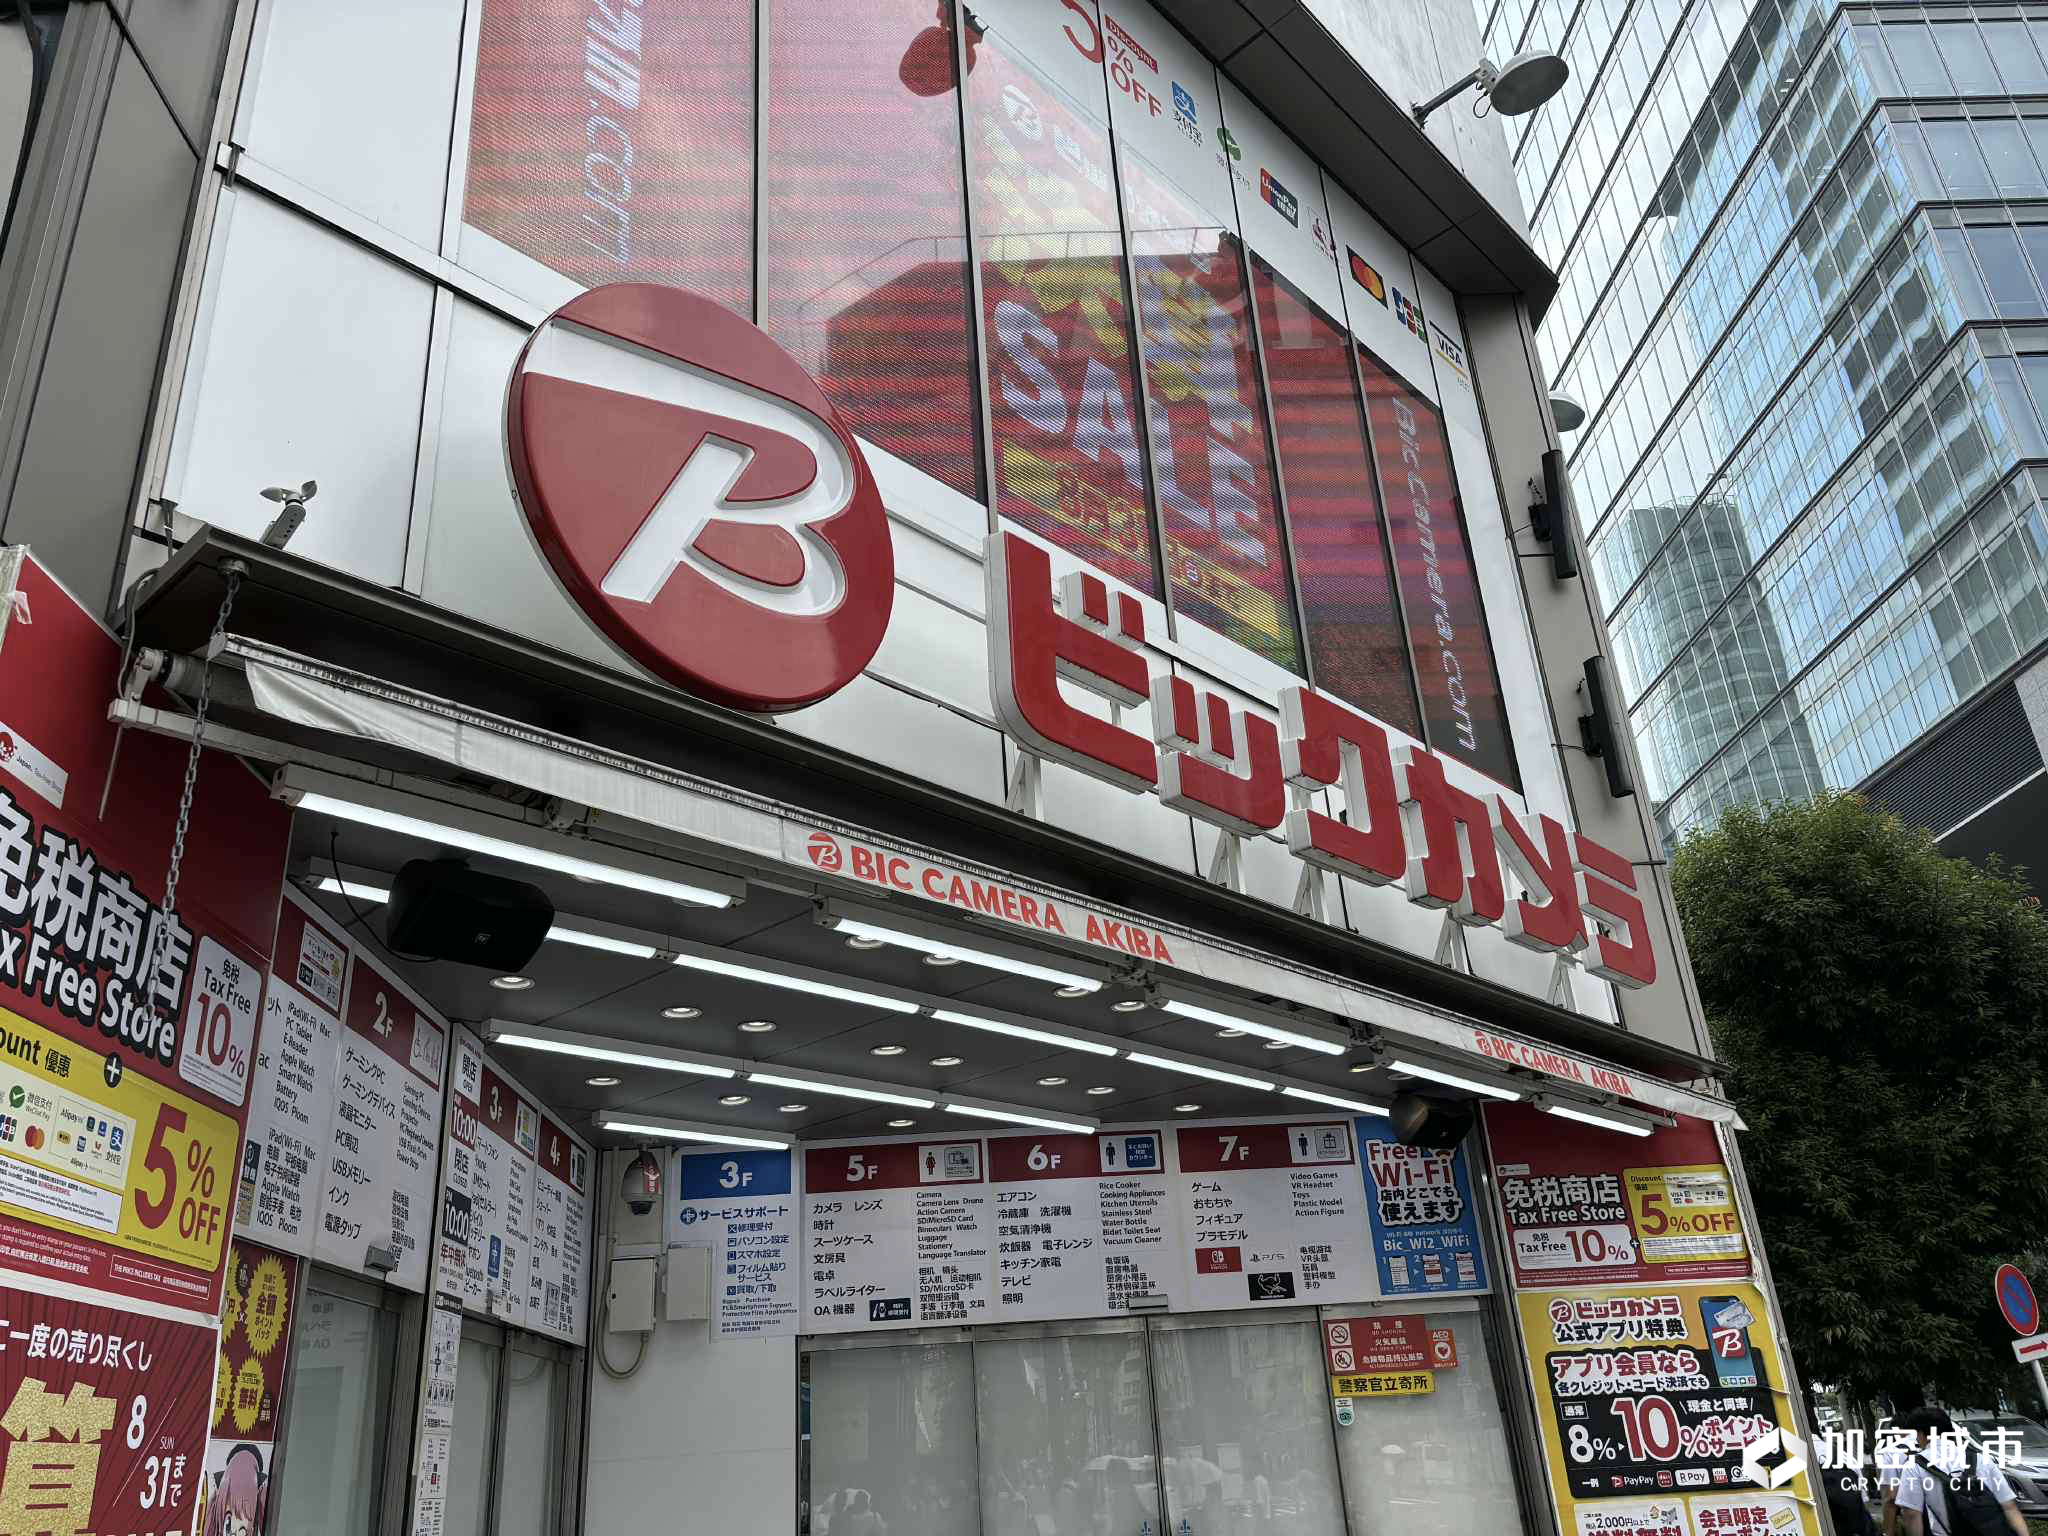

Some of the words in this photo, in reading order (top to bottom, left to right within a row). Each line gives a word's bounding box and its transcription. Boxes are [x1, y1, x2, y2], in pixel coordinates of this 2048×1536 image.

[1111, 62, 1162, 117] OFF
[1435, 332, 1463, 369] VISA
[994, 300, 1268, 567] SALE
[986, 529, 1657, 990] ビックカメラ
[851, 845, 914, 891] BIC
[922, 868, 1066, 934] CAMERA
[1086, 914, 1174, 964] AKIBA
[25, 935, 97, 1017] Free
[101, 978, 176, 1058] Store
[203, 966, 225, 995] Tax
[225, 982, 251, 1015] Free
[372, 991, 393, 1039] 2F
[196, 992, 245, 1079] 10%
[1491, 1036, 1521, 1065] BIC
[1521, 1046, 1585, 1083] CAMERA
[1591, 1065, 1635, 1097] AKIBA
[453, 1104, 476, 1147] 10:00
[1218, 1135, 1249, 1162] 7F
[1368, 1142, 1419, 1161] Free
[1026, 1144, 1061, 1171] 6F
[332, 1156, 372, 1185] USBメモリー
[719, 1160, 753, 1189] 3F
[846, 1154, 879, 1182] 5F
[1371, 1158, 1452, 1188] Wi-Fi
[1290, 1172, 1312, 1181] Video
[1313, 1171, 1339, 1180] Games
[261, 1176, 281, 1195] Apple
[281, 1184, 300, 1203] Watch
[1099, 1182, 1114, 1190] Rice
[1115, 1181, 1141, 1189] Cooker
[1191, 1181, 1222, 1193] ゲーム
[1291, 1182, 1303, 1190] VR
[1303, 1180, 1334, 1189] Headset
[1503, 1174, 1621, 1208] 免税商店
[328, 1186, 350, 1206] インク
[916, 1191, 942, 1199] Camera
[997, 1191, 1038, 1203] エアコン
[1100, 1190, 1128, 1199] Cooking
[1129, 1189, 1166, 1199] Appliances
[1292, 1191, 1310, 1200] Toys
[1380, 1185, 1455, 1202] 店内どこでも
[813, 1201, 843, 1215] カメラ
[854, 1199, 883, 1212] レンズ
[916, 1200, 943, 1208] Camera
[1101, 1200, 1128, 1208] Kitchen
[1129, 1198, 1158, 1207] Utensils
[1193, 1198, 1233, 1210] おもちゃ
[1293, 1199, 1318, 1208] Plastic
[1319, 1198, 1343, 1207] Model
[1381, 1198, 1460, 1223] 使えます
[699, 1205, 789, 1222] サービスサポート
[917, 1208, 939, 1216] Action
[998, 1207, 1030, 1219] 冷蔵庫
[1039, 1205, 1072, 1217] 洗濯機
[1101, 1208, 1133, 1217] Stainless
[1134, 1207, 1153, 1216] Steel
[1195, 1213, 1244, 1226] フィギュア
[1295, 1208, 1320, 1217] Action
[1320, 1207, 1345, 1217] Figure
[1507, 1209, 1539, 1225] Tax
[1541, 1207, 1578, 1223] Free
[1580, 1204, 1626, 1221] Store
[179, 1196, 221, 1246] OFF
[257, 1210, 274, 1227] IQOS
[278, 1217, 298, 1235] Ploom
[444, 1202, 469, 1242] 10:00
[737, 1222, 773, 1233] 修理受付
[813, 1219, 834, 1231] 時計
[956, 1222, 978, 1231] Watch
[1102, 1218, 1124, 1227] Water
[1125, 1217, 1148, 1226] Bottle
[1691, 1212, 1737, 1233] OFF
[998, 1223, 1052, 1236] 空気清浄機
[1196, 1229, 1249, 1243] プラモデル
[737, 1234, 790, 1246] パソコン設定
[813, 1233, 874, 1248] スーツケース
[917, 1235, 947, 1243] Luggage
[999, 1240, 1032, 1254] 炊飯器
[1041, 1238, 1093, 1251] 電子レンジ
[1103, 1237, 1133, 1246] Vacuum
[1134, 1235, 1162, 1244] Cleaner
[1518, 1241, 1539, 1254] Tax
[1541, 1240, 1567, 1252] Free
[1566, 1229, 1629, 1263] 10%
[737, 1248, 782, 1260] スマホ設定
[918, 1243, 953, 1251] Stationery
[918, 1251, 952, 1260] Language
[953, 1248, 987, 1257] Translator
[813, 1252, 847, 1264] 文房具
[1000, 1256, 1062, 1270] キッチン家電
[737, 1262, 786, 1273] フィルム貼り
[737, 1272, 772, 1284] サービス
[813, 1270, 835, 1282] 電卓
[1001, 1274, 1032, 1287] テレビ
[814, 1285, 886, 1299] ラベルライター
[1002, 1292, 1024, 1305] 照明
[1575, 1296, 1682, 1320] ビックカメラ
[1432, 1330, 1449, 1339] AED
[1555, 1317, 1687, 1343] 公式アプリ特典
[1553, 1350, 1699, 1379] アプリ会員なら
[1338, 1375, 1428, 1393] 警察官立寄所
[1557, 1376, 1708, 1395] 各クレジット・コード決済でも
[1565, 1407, 1585, 1417] 通常
[126, 1394, 148, 1450] 8
[160, 1436, 175, 1450] SUN
[1567, 1424, 1617, 1463] 8%
[1612, 1395, 1711, 1462] 10%
[1704, 1416, 1773, 1436] ポイント
[140, 1456, 172, 1509] 31
[170, 1453, 187, 1508] まで
[1623, 1475, 1654, 1486] PayPay
[1687, 1472, 1705, 1483] Pay
[1698, 1506, 1769, 1529] 会員限定
